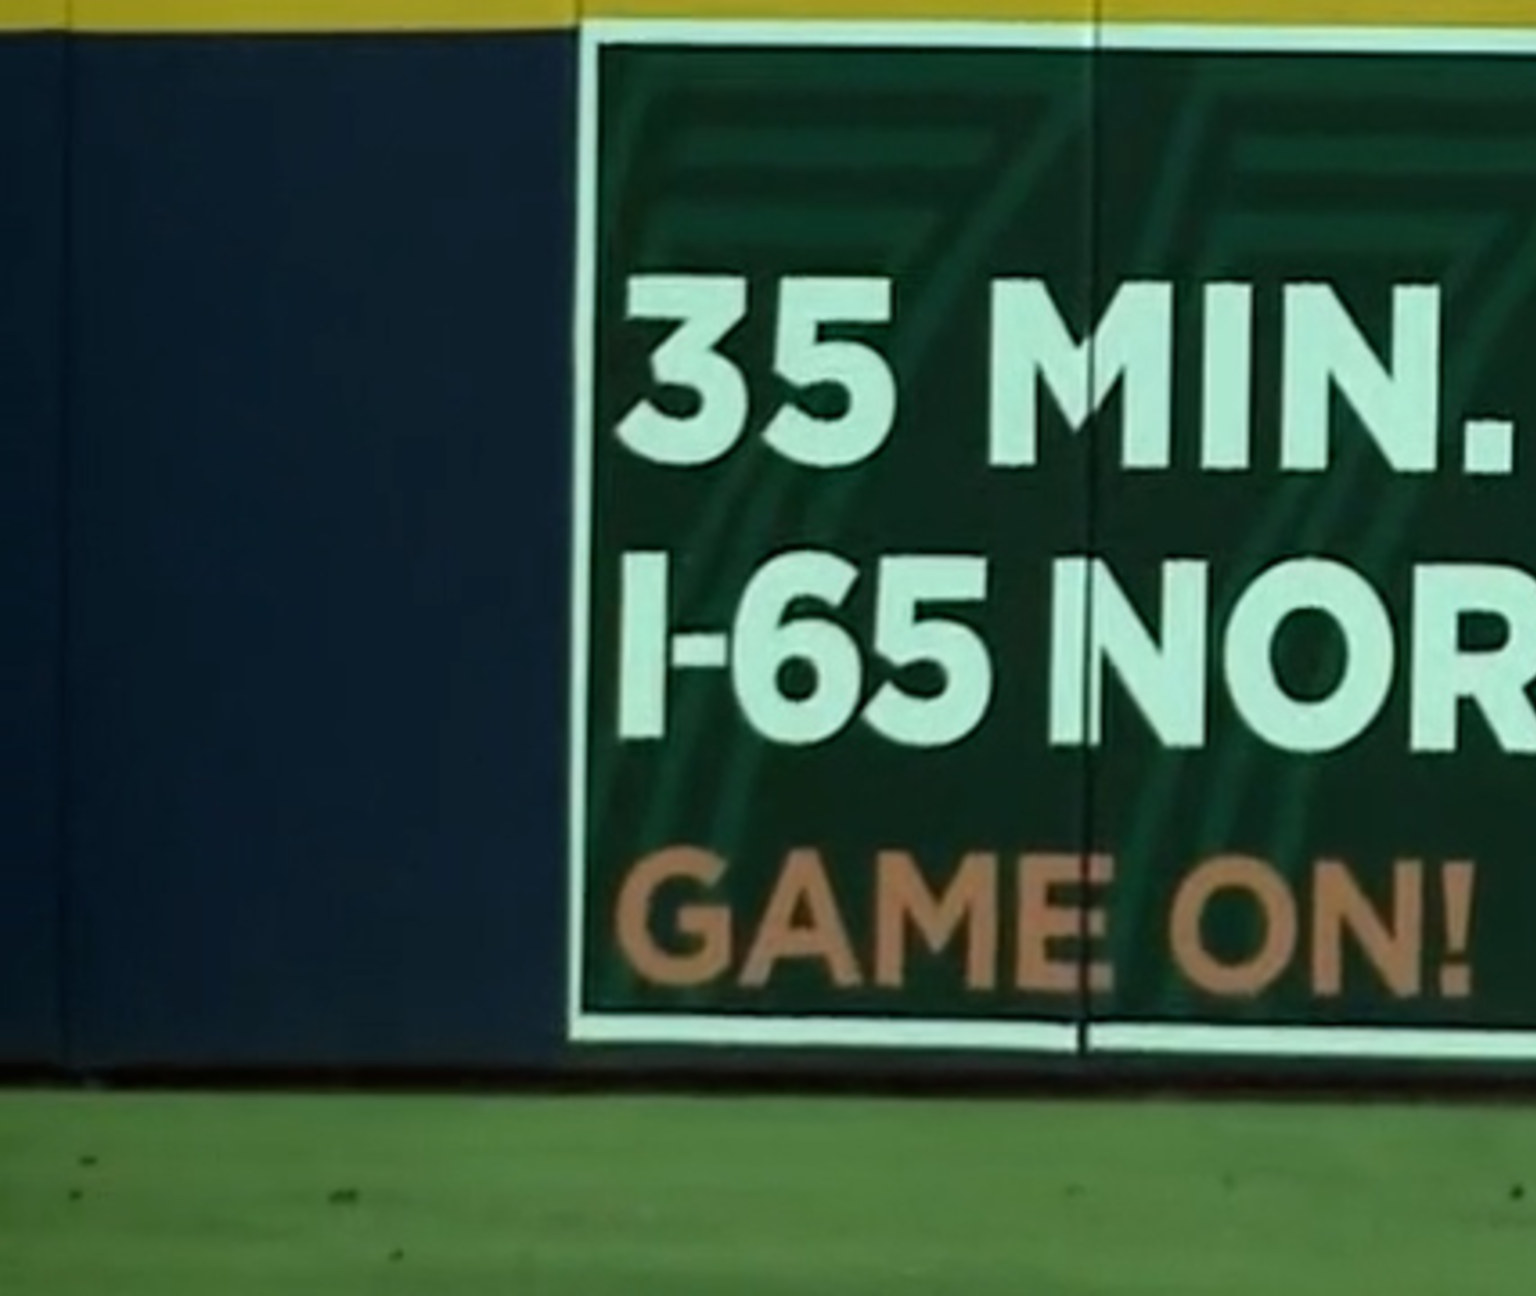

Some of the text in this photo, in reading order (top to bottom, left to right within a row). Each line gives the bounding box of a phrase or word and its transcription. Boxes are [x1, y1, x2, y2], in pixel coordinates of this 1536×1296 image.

[615, 274, 1515, 474] 35 MIN.
[617, 549, 993, 748] I-65
[615, 846, 1475, 997] GAME ON!
